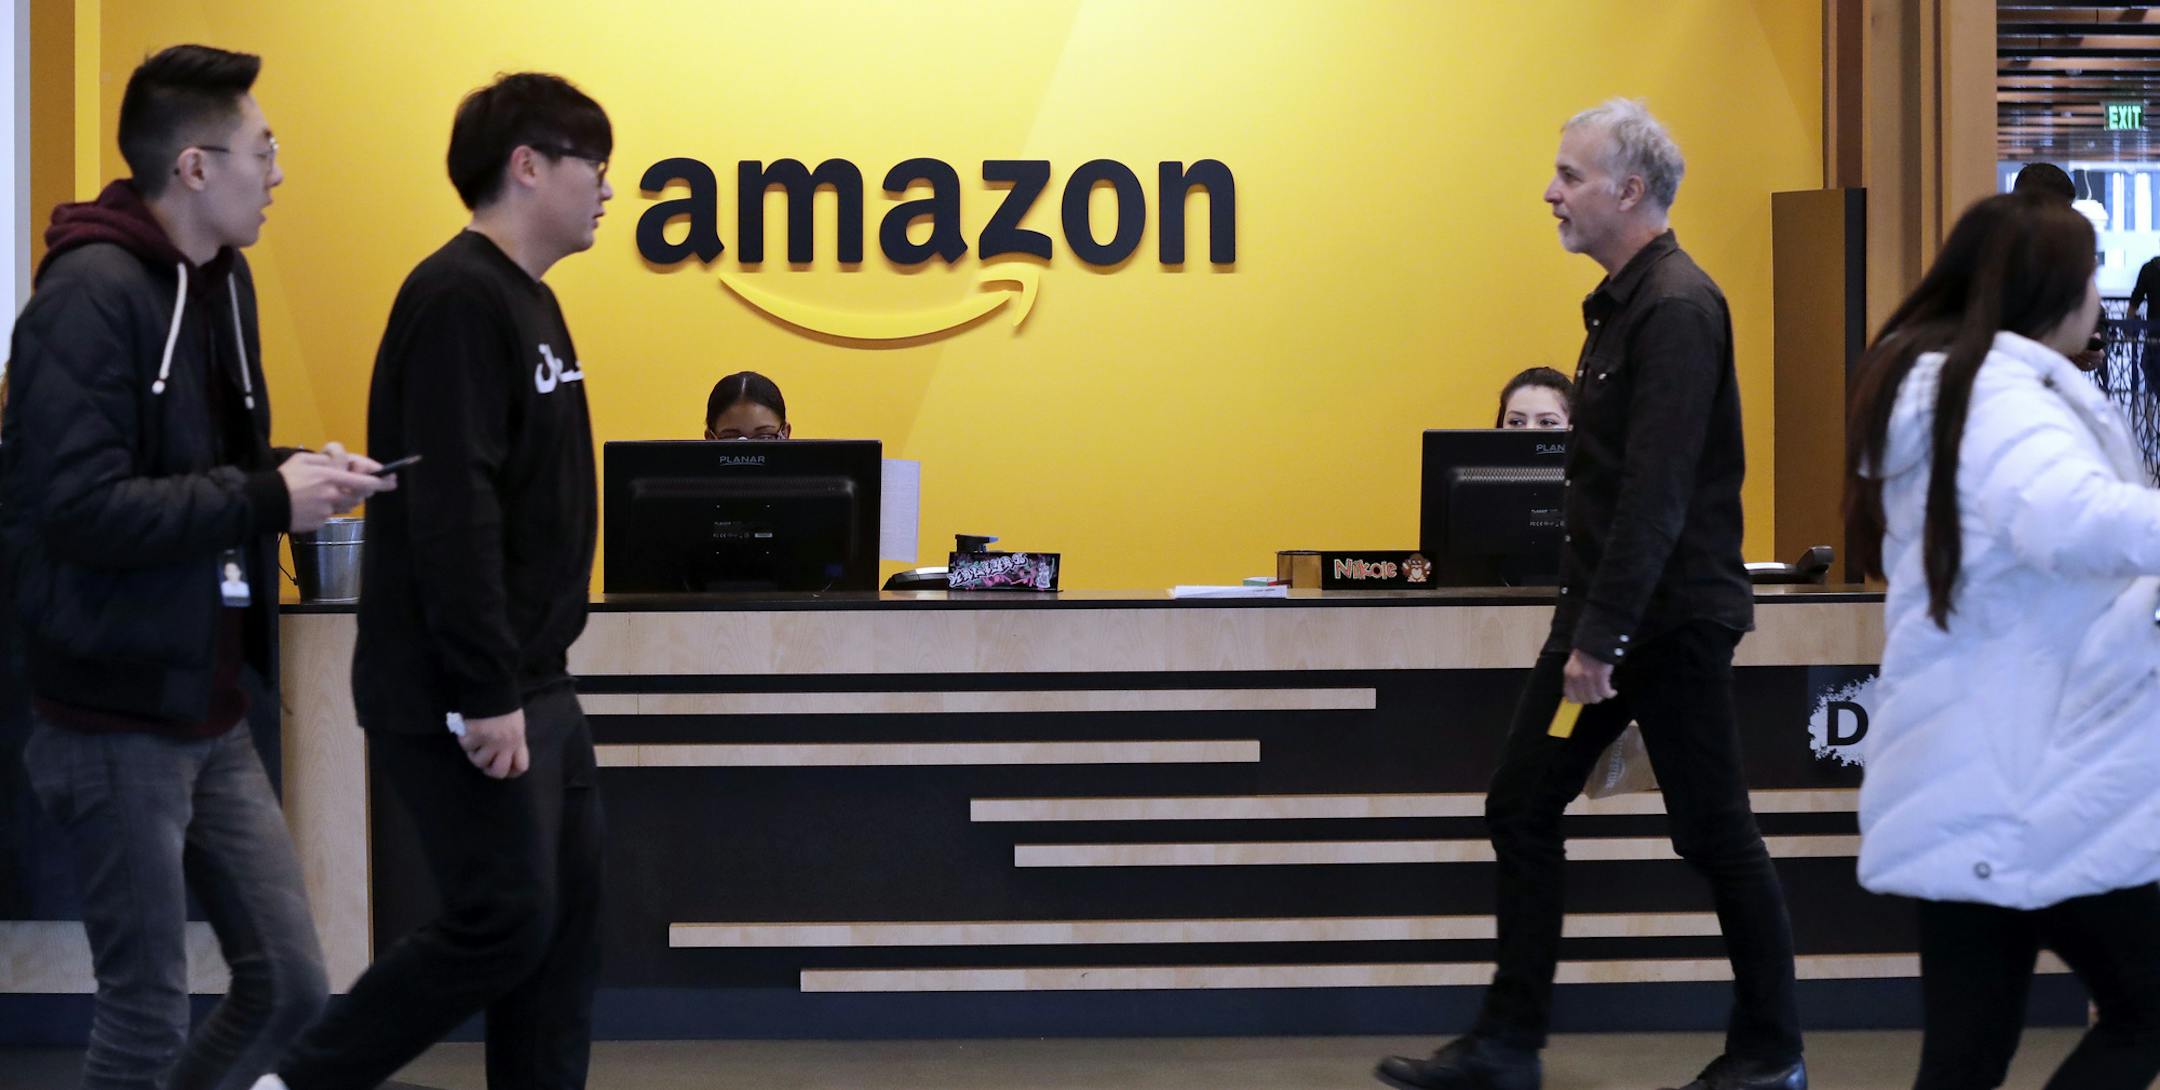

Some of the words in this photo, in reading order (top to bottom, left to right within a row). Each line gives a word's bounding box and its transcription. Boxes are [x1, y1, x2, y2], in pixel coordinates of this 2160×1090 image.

[2109, 105, 2141, 130] EXIT
[635, 157, 1236, 264] amazon
[719, 455, 766, 464] PLANAR
[1536, 443, 1566, 452] PLAN
[1827, 700, 1869, 746] D
